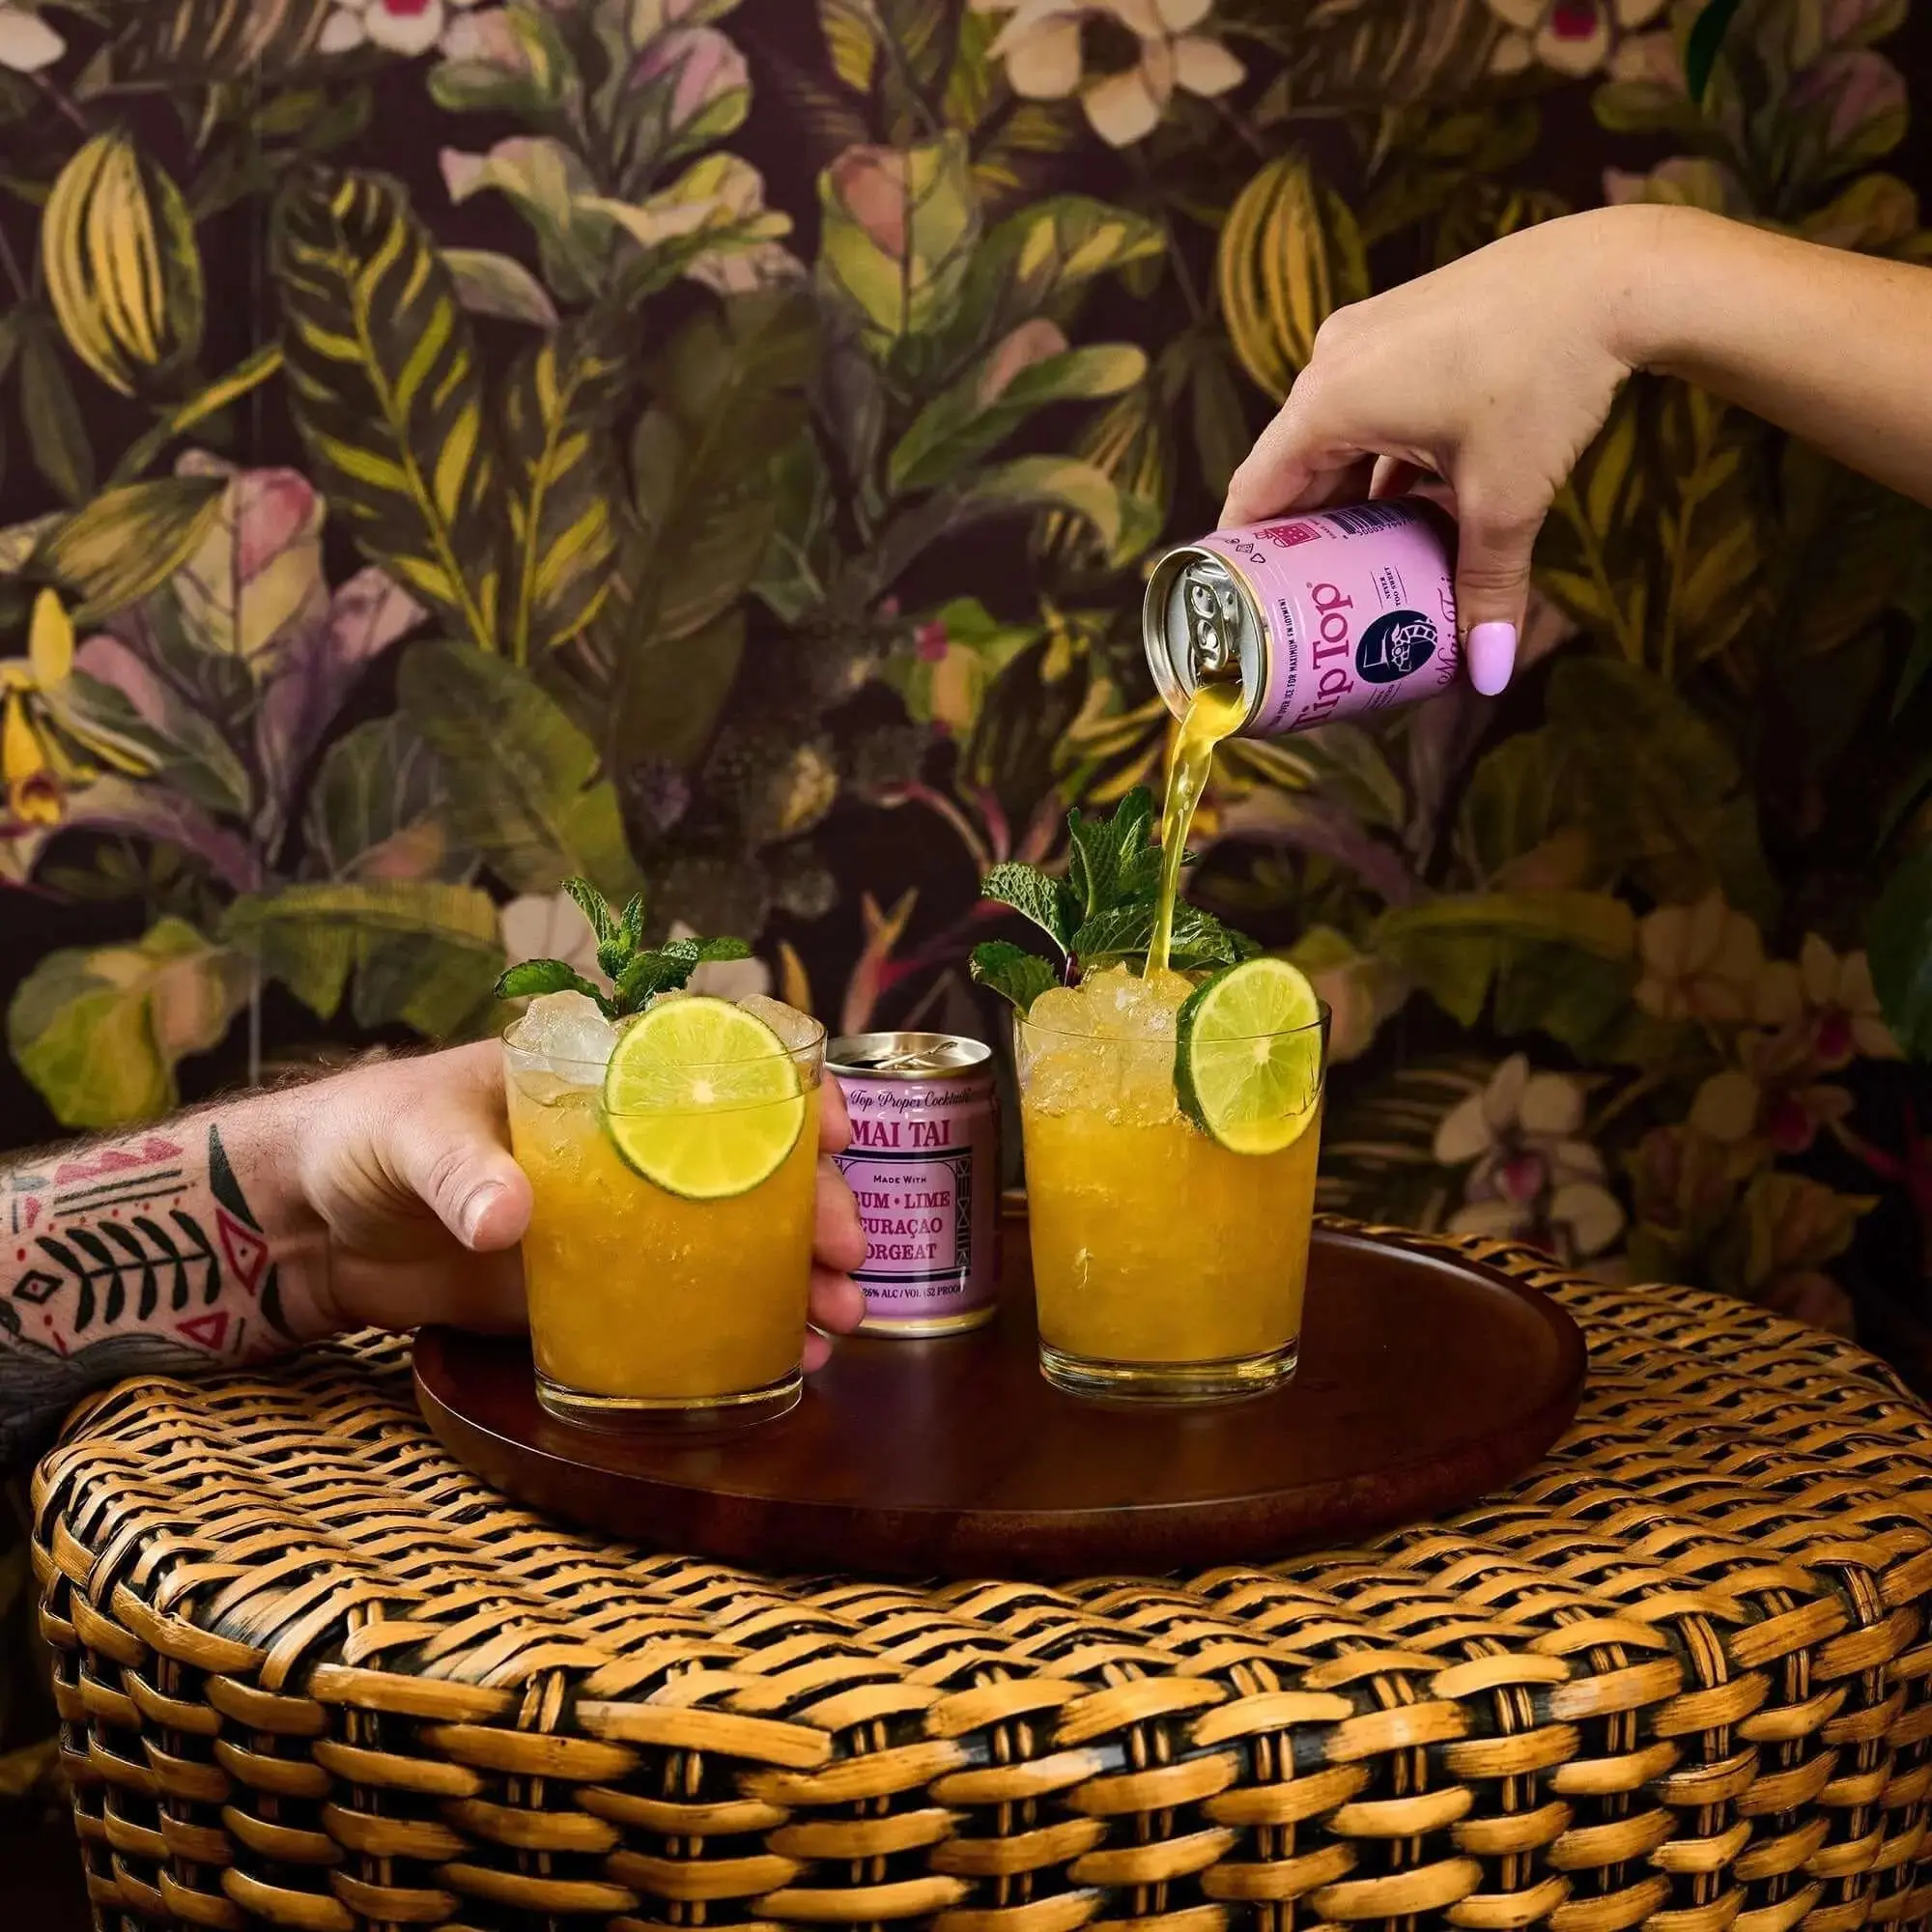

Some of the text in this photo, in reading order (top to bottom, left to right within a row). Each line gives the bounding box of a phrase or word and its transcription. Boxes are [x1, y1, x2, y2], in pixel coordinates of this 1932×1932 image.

[1379, 577, 1391, 599] NEVER
[1384, 566, 1397, 589] SWEET
[1289, 639, 1298, 672] MAXIMUM
[1287, 674, 1297, 687] FOR
[1284, 689, 1294, 698] ICE
[850, 1089, 874, 1112] Top
[878, 1092, 921, 1114] Proper
[851, 1120, 951, 1148] MAI TAI
[904, 1191, 951, 1209] LIME
[881, 1289, 898, 1298] ALC
